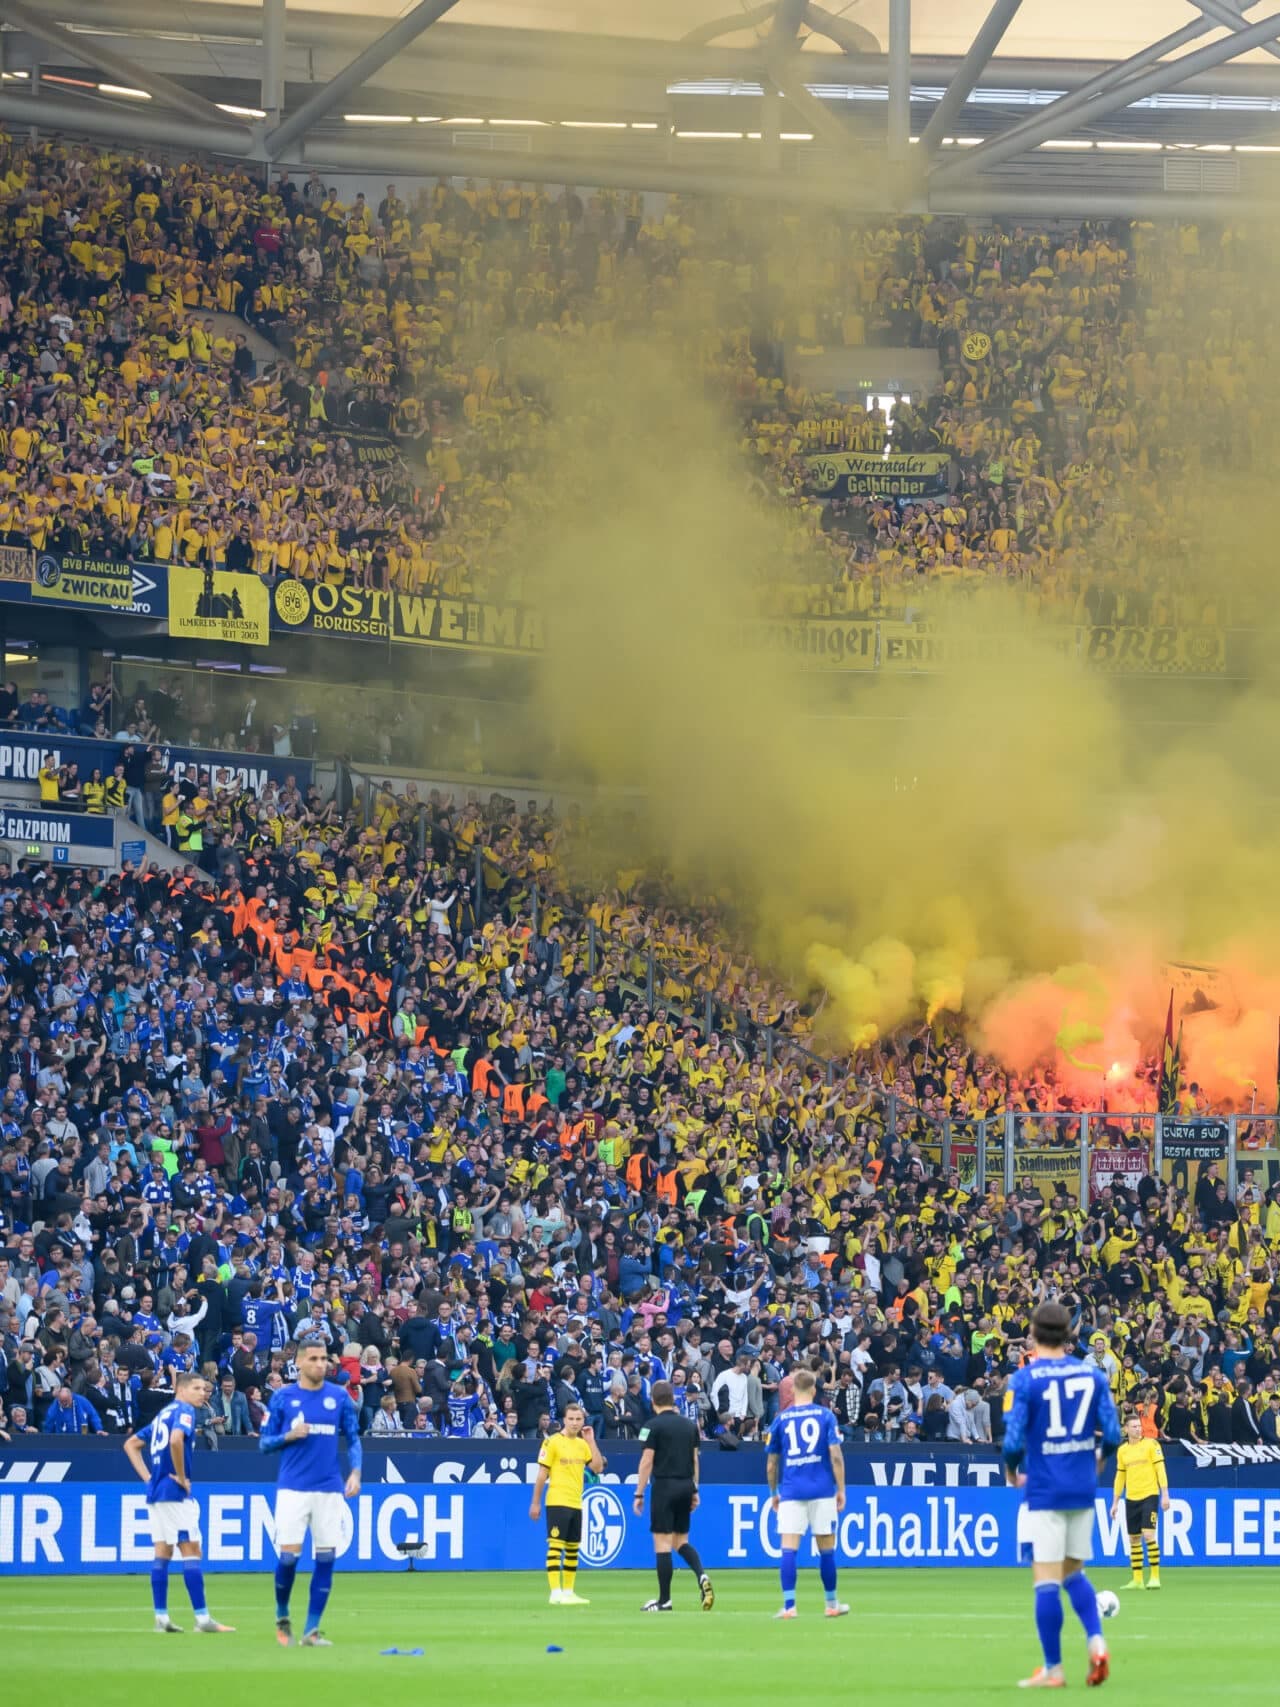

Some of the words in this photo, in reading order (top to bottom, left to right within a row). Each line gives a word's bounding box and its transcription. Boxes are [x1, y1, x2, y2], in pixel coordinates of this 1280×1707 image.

[845, 456, 926, 473] Werrataler
[62, 558, 82, 570] BVB
[84, 561, 130, 576] FANCLUB
[62, 578, 129, 600] ZWICKAU
[312, 582, 390, 619] OST
[7, 817, 70, 843] GAZPROM
[1163, 1127, 1195, 1139] CURVA
[1201, 1127, 1220, 1139] SUD
[1164, 1146, 1191, 1157] RESTA
[1194, 1146, 1220, 1158] FORTE
[247, 1309, 256, 1324] 8
[1042, 1376, 1095, 1437] 17
[784, 1417, 820, 1456] 19
[811, 1495, 999, 1558] chalke
[1094, 1499, 1194, 1556] WR
